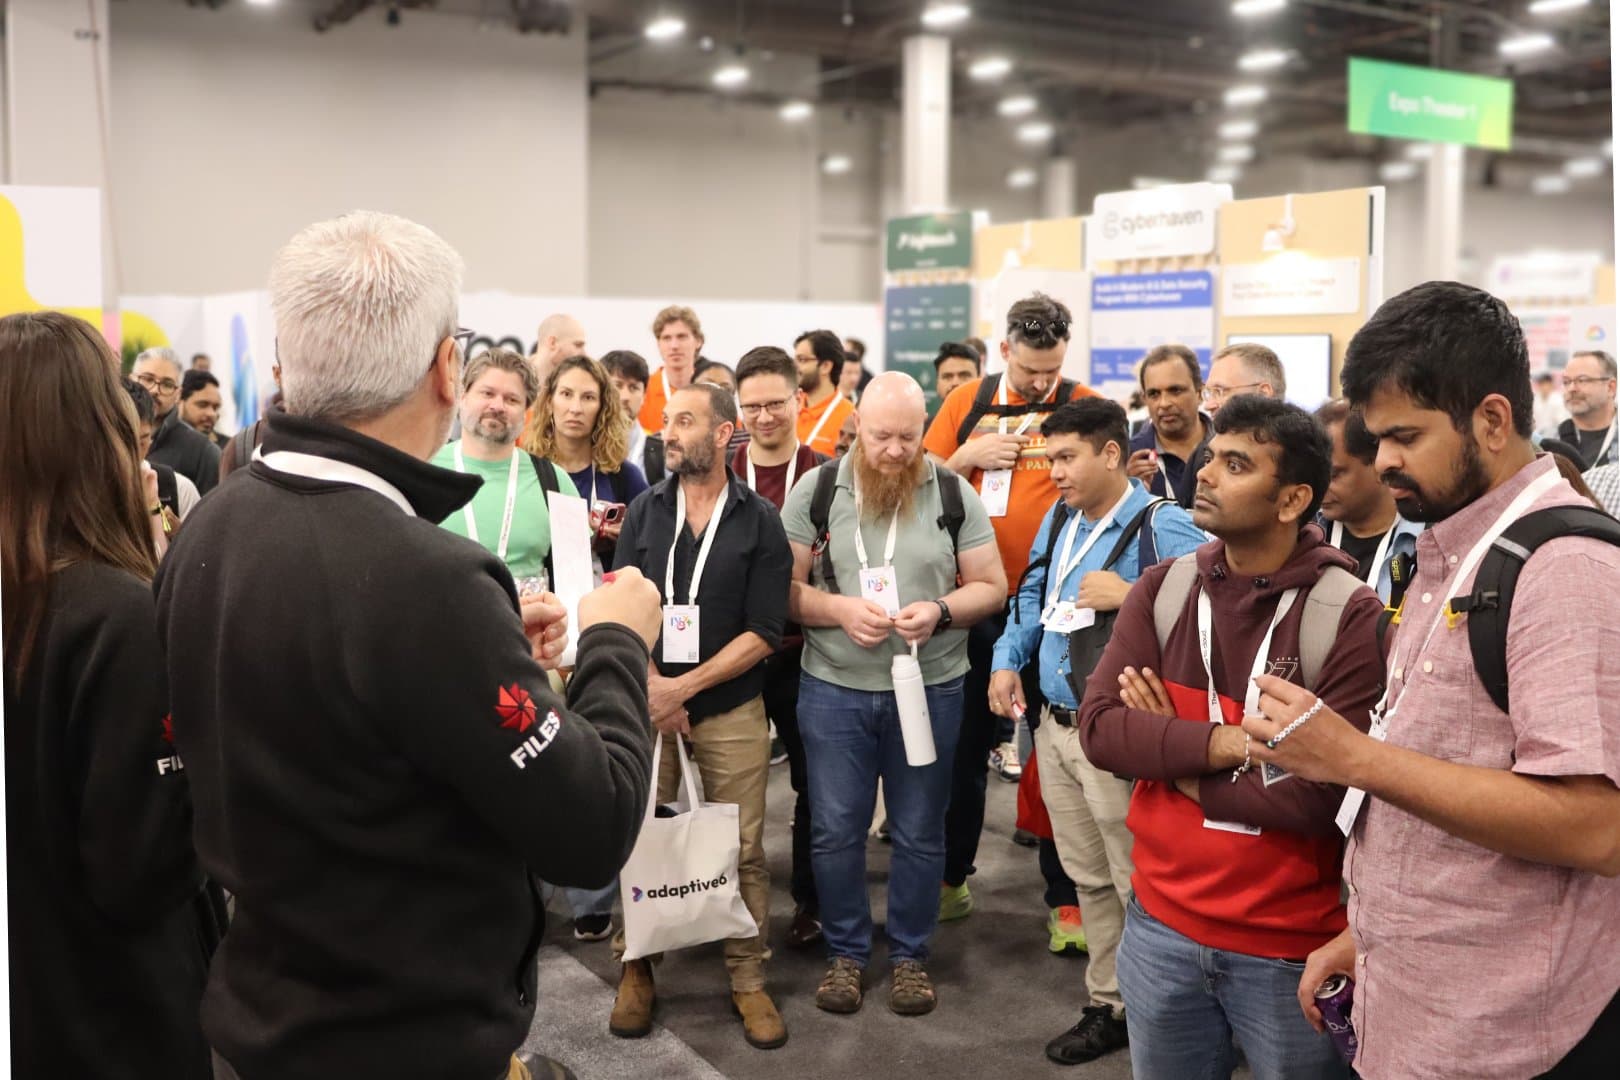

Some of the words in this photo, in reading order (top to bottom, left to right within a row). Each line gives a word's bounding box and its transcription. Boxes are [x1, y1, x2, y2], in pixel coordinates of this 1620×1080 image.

[1121, 209, 1204, 234] cyberhaven
[1026, 460, 1052, 470] PAR
[510, 711, 560, 769] FILES
[157, 755, 184, 775] FIL
[647, 872, 728, 898] adaptive6
